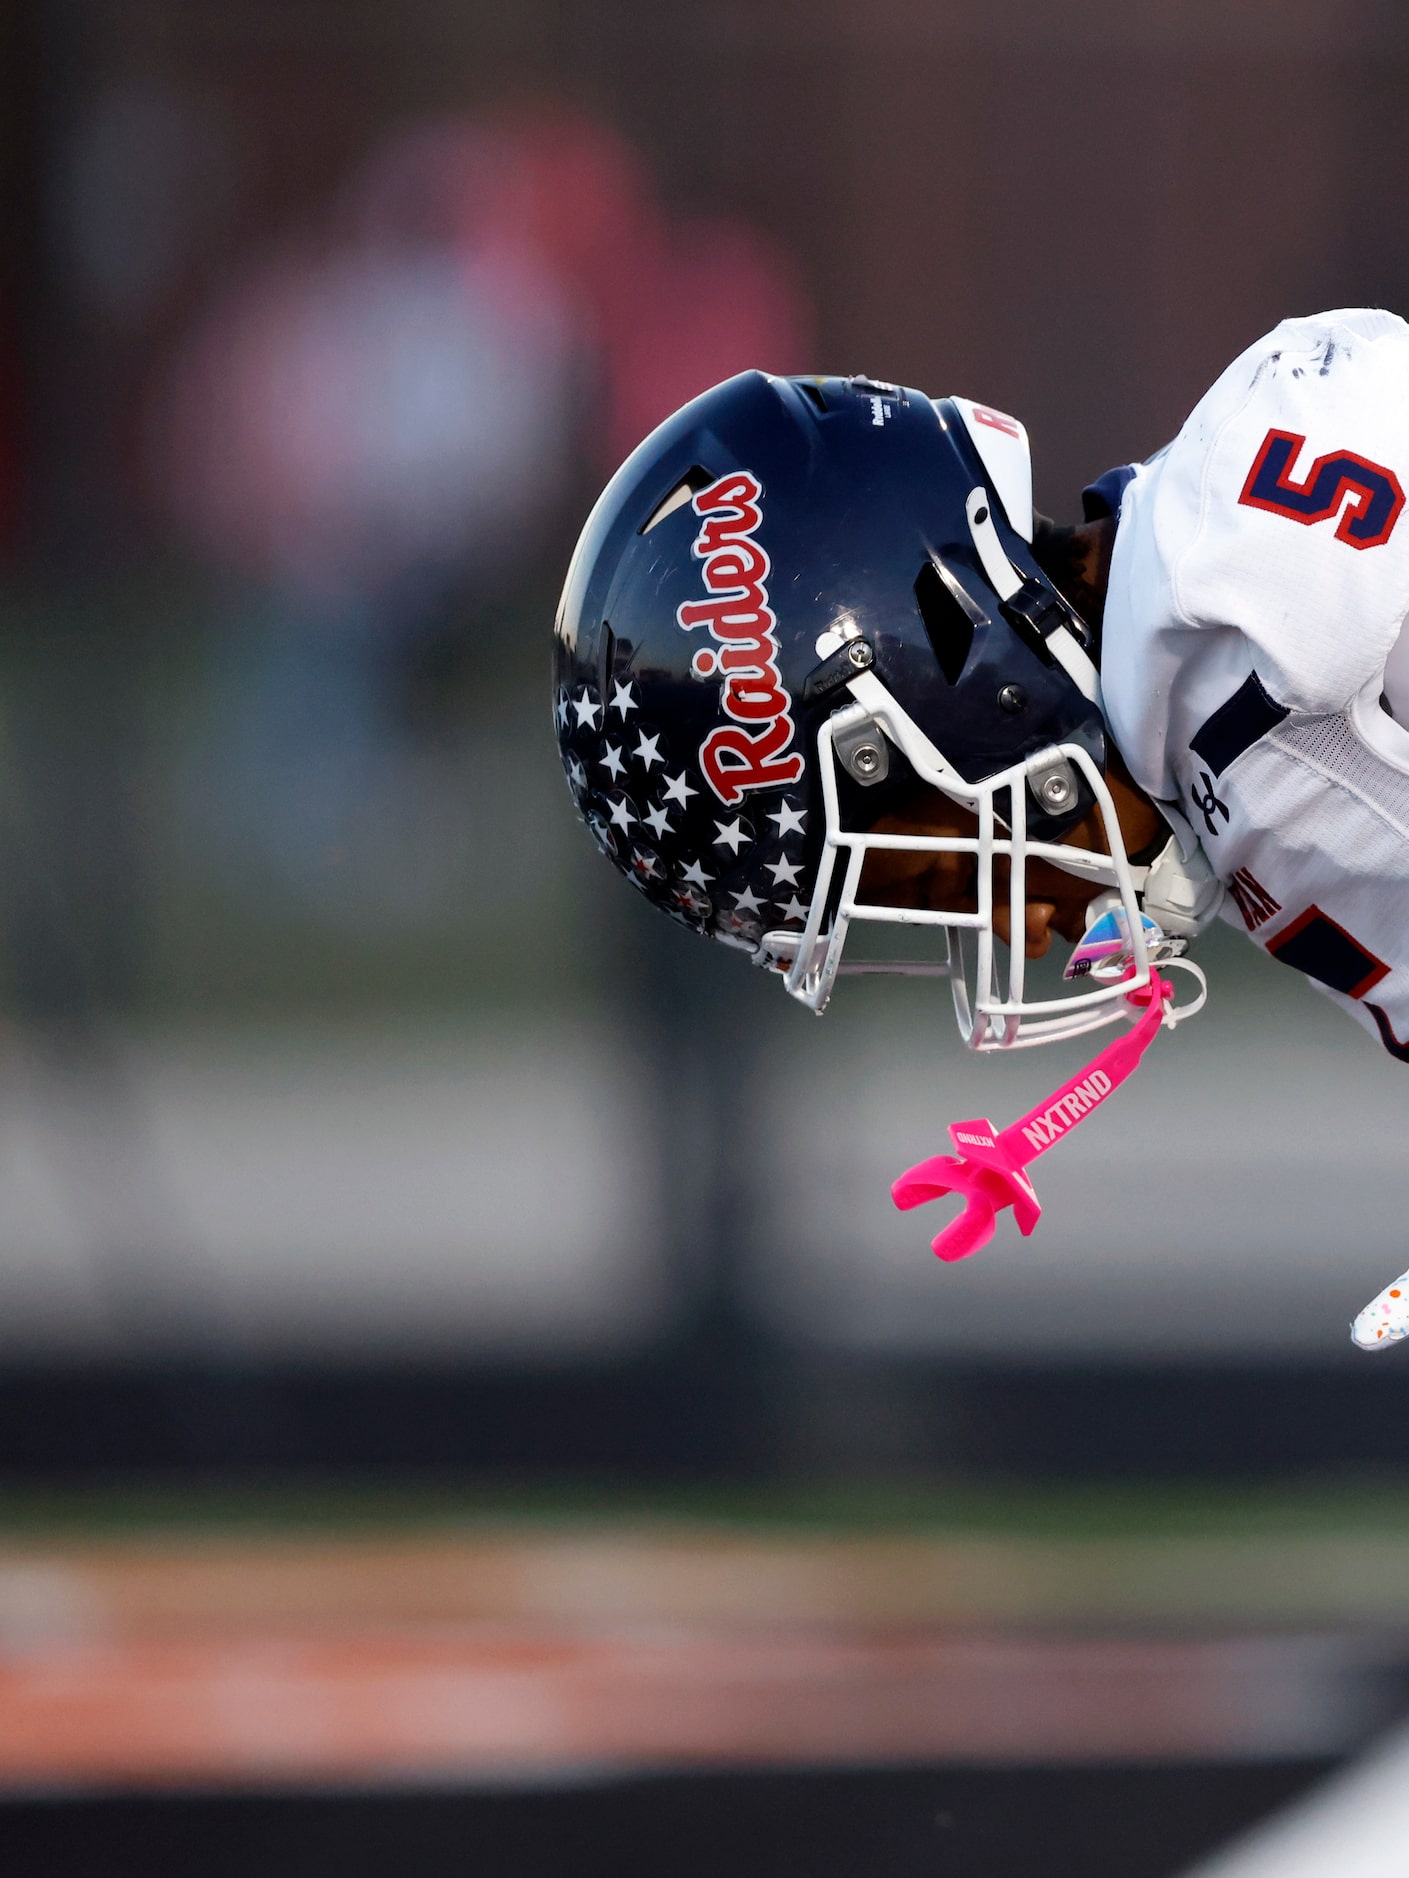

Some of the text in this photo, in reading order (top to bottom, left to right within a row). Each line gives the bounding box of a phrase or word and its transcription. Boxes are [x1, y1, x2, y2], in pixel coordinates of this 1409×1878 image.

[1238, 427, 1407, 551] 5
[678, 470, 805, 806] Raiders
[956, 1131, 995, 1148] NXTRND
[1021, 1069, 1112, 1151] NXTRND
